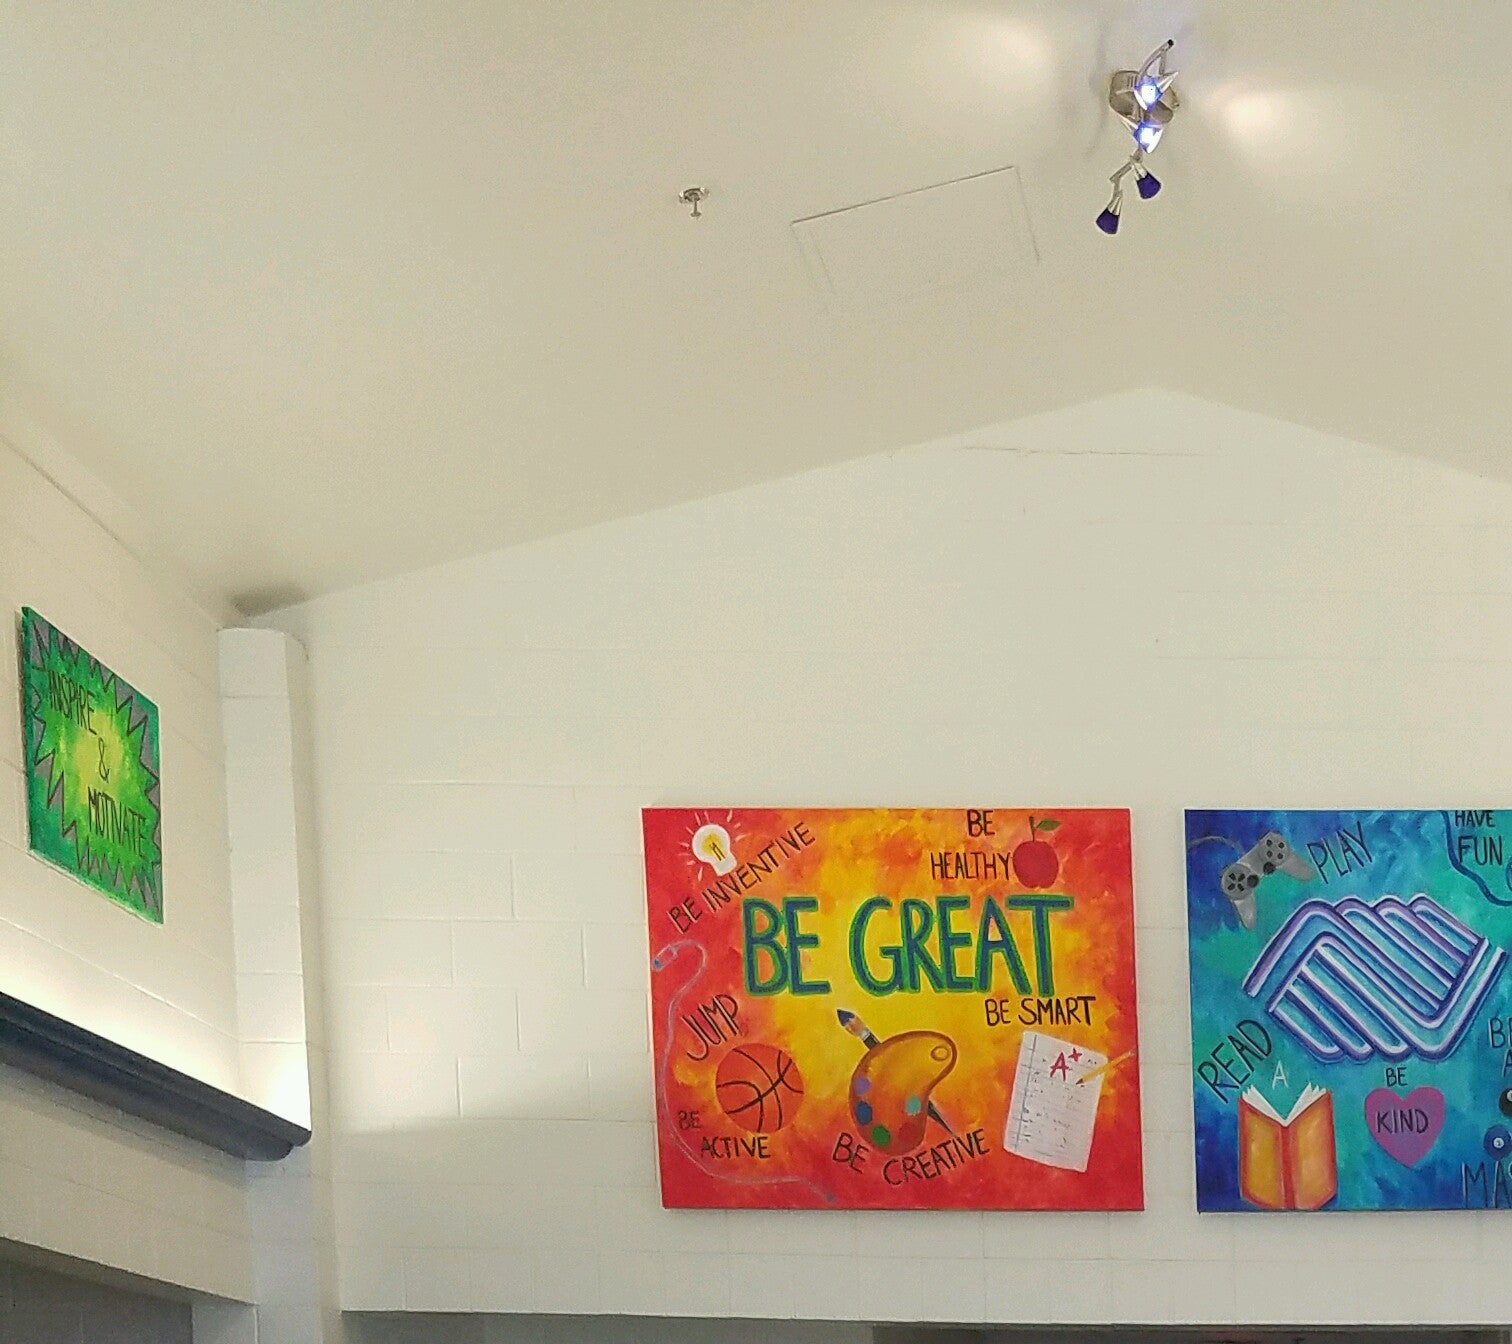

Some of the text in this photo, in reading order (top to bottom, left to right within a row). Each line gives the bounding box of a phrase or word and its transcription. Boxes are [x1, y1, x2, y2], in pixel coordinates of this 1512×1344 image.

[967, 809, 995, 838] BE
[1454, 809, 1497, 828] HAVE
[930, 851, 1015, 882] HEALTHY
[1307, 820, 1373, 885] PLAY
[1458, 836, 1504, 867] FUN
[667, 821, 816, 934] BE INVENTIVE
[741, 894, 1075, 998] BE GREAT
[984, 995, 1097, 1028] BE SMART
[681, 993, 744, 1062] JUMP
[1197, 1018, 1274, 1104] READ
[1271, 1061, 1288, 1087] A
[1385, 1067, 1407, 1087] BE
[678, 1110, 700, 1130] BE
[1376, 1108, 1429, 1135] KIND
[700, 1135, 771, 1160] ACTIVE
[831, 1128, 991, 1186] BE CREATIVE
